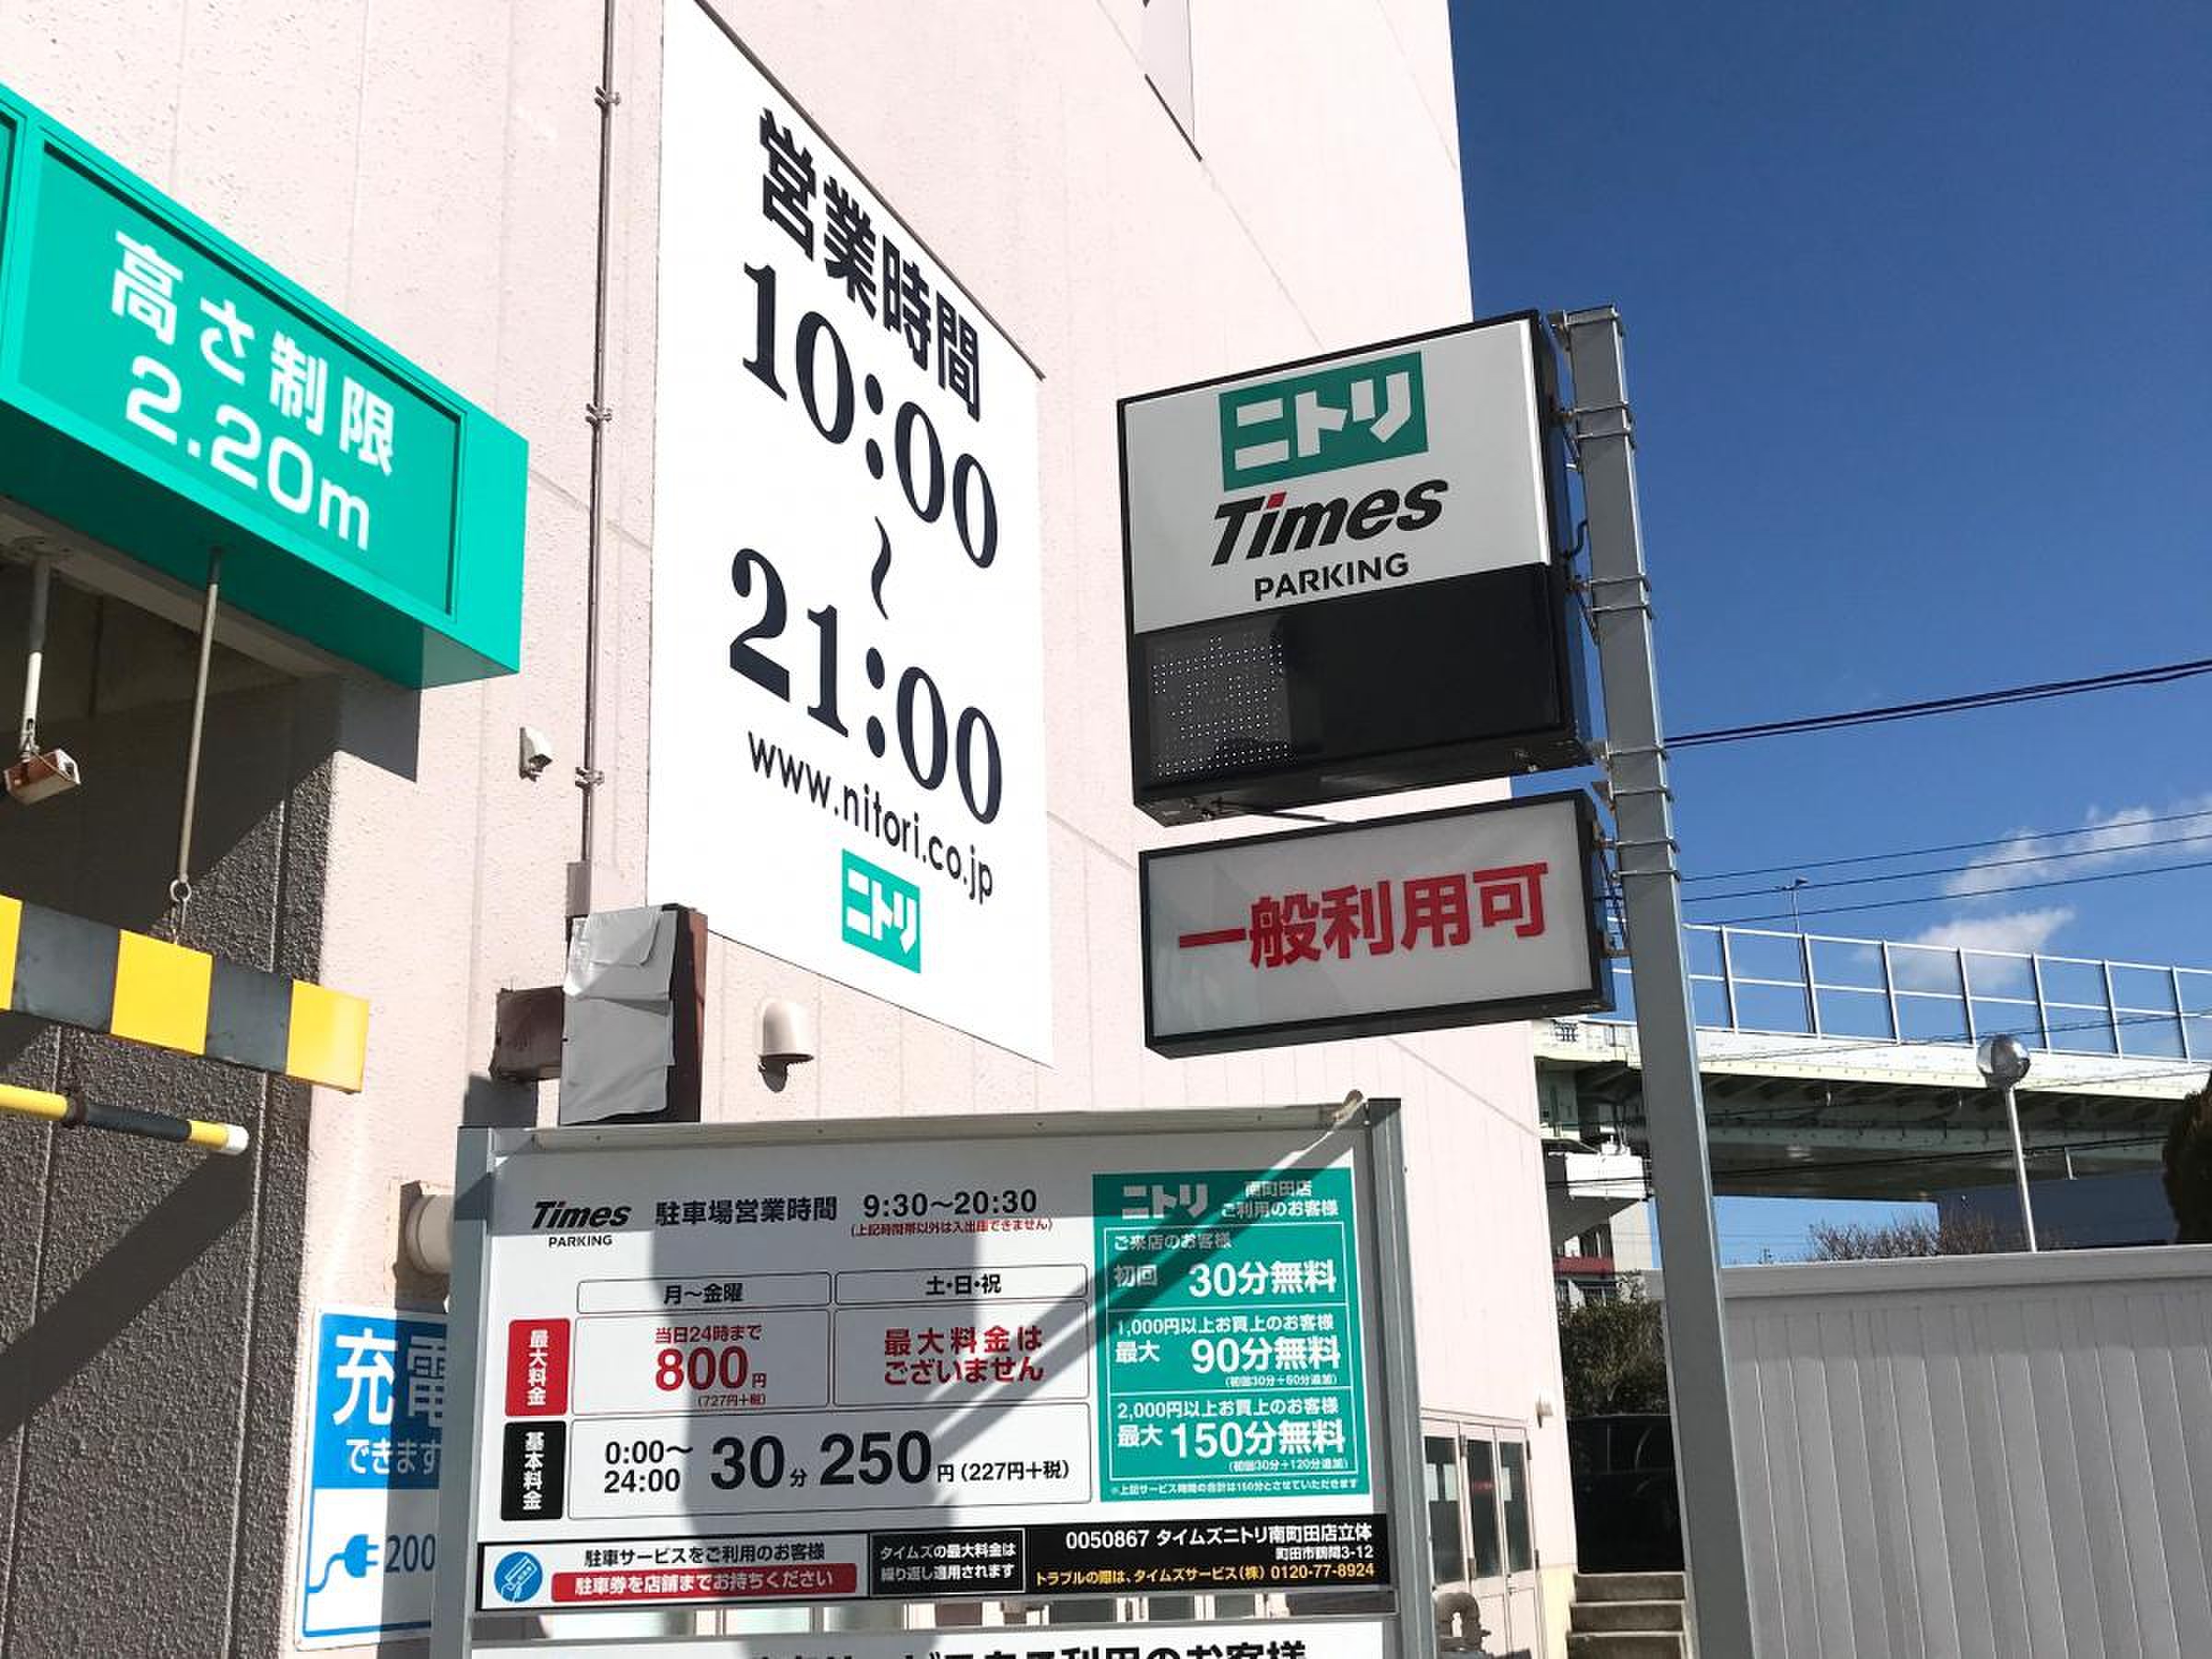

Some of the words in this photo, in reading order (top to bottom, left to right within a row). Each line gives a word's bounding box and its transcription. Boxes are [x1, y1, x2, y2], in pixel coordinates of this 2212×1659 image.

[759, 107, 980, 422] 営業時間
[112, 230, 394, 476] 高さ制限
[742, 262, 997, 568] 10:00
[1235, 371, 1411, 470] ニトリ
[125, 355, 370, 551] 2.20m
[1211, 479, 1448, 567] Times
[1254, 553, 1408, 602] PARKING
[730, 547, 1002, 824] 21:00
[748, 731, 993, 903] www.nitori.co.jp
[847, 868, 917, 954] ニトリ
[1179, 862, 1548, 969] 一般利用可
[531, 1200, 632, 1230] Times
[655, 1196, 838, 1226] 駐車場営業時間
[1122, 1183, 1209, 1220] ニトリ
[1221, 1199, 1339, 1218] ご利用のお客様
[548, 1234, 613, 1248] PARKING
[1113, 1232, 1233, 1252] ご来店のお客様
[1113, 1264, 1159, 1288] 初回
[1188, 1260, 1336, 1298] 30分無料
[655, 1324, 762, 1345] 当日24時まで
[885, 1325, 1042, 1357] 最大料金は
[527, 1329, 548, 1407] 最大料金
[884, 1356, 1043, 1385] ございません
[1115, 1340, 1160, 1364] 最大
[1191, 1335, 1341, 1374] 90分無料
[347, 1439, 441, 1475] できます
[1117, 1424, 1163, 1447] 最大
[1171, 1418, 1346, 1460] 150分無料
[523, 1431, 545, 1511] 基本料金
[604, 1468, 680, 1494] 24:00
[385, 1534, 436, 1573] 200
[584, 1542, 826, 1568] 駐車サービスをご利用のお客様
[880, 1542, 1017, 1560] タイムズの最大料金は
[1065, 1529, 1149, 1549] 0050867
[1157, 1523, 1372, 1547] タイムズニトリ南町田店立体
[575, 1570, 833, 1595] 駐車券を店舗までお持ちください
